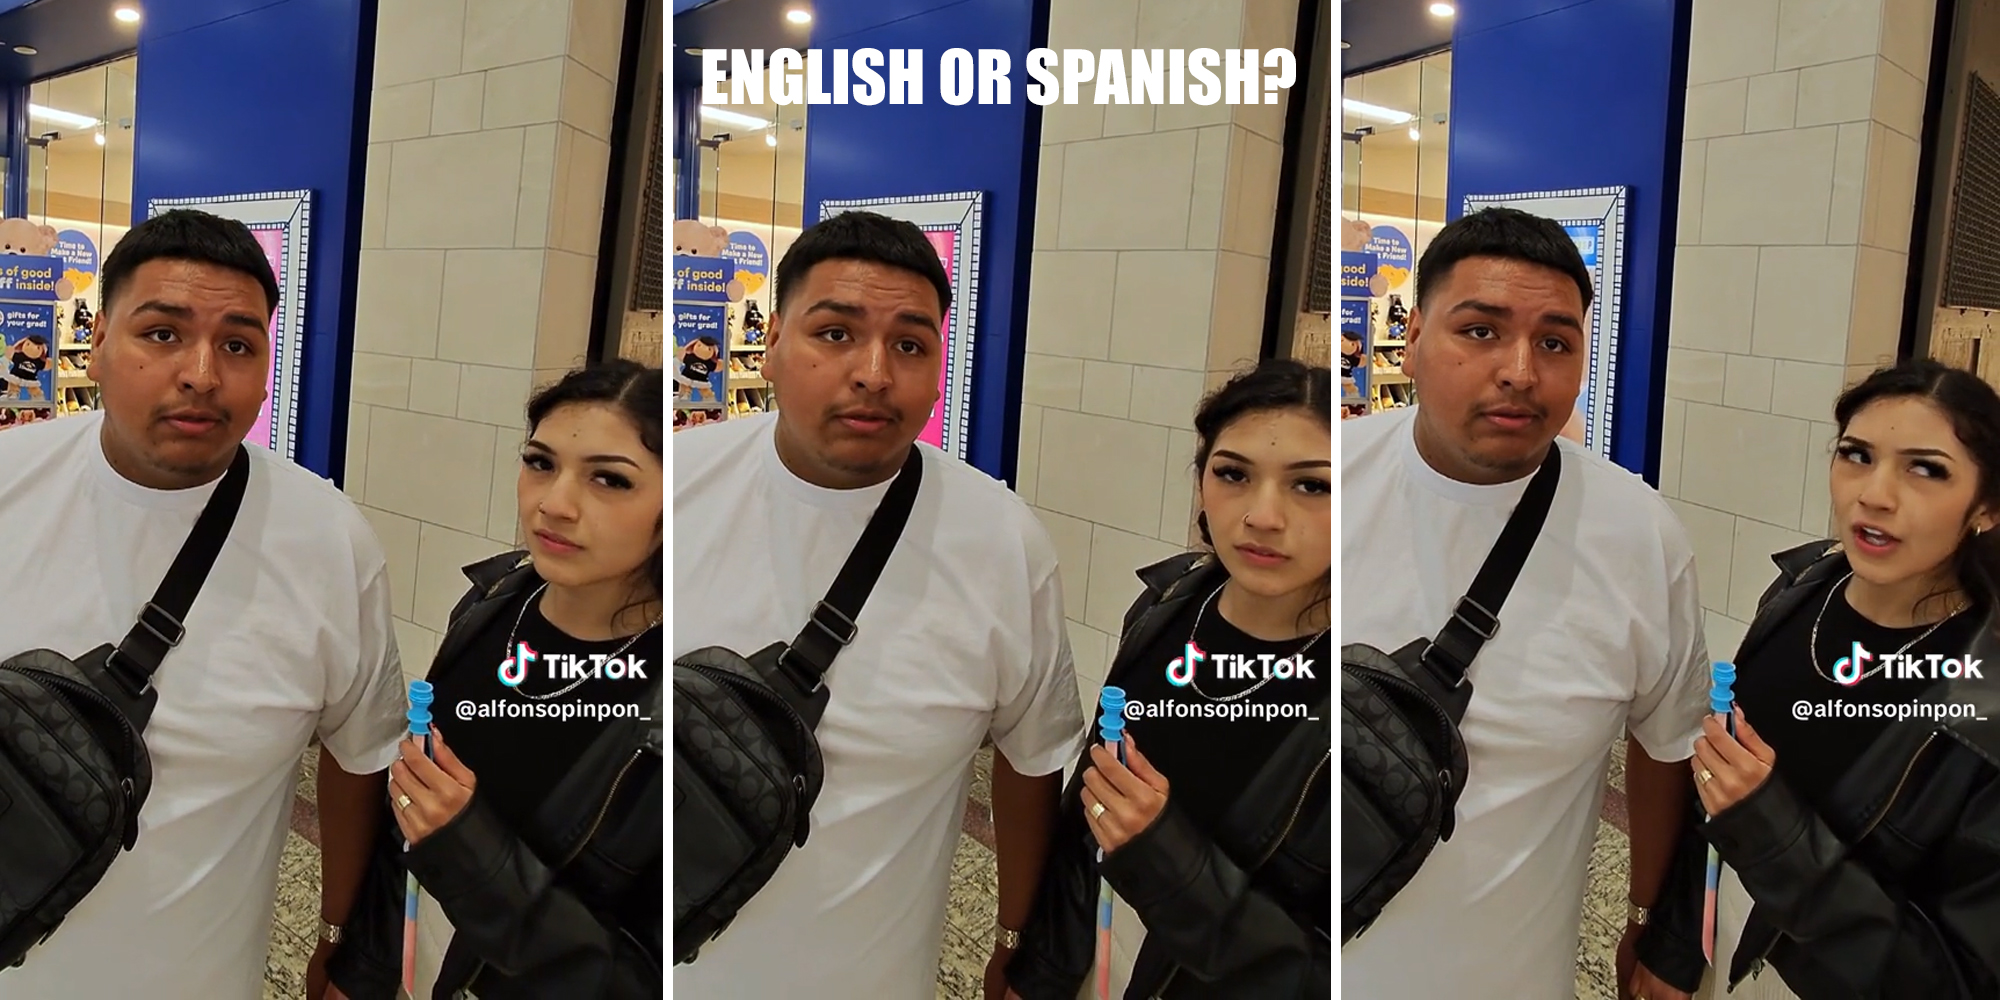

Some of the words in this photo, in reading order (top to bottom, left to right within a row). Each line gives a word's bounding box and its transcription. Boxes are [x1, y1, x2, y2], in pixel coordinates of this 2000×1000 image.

[59, 241, 76, 250] Time
[77, 242, 85, 250] to
[1373, 237, 1390, 245] Time
[1392, 238, 1399, 246] to
[730, 242, 747, 250] Time
[748, 243, 756, 251] to
[1365, 243, 1384, 251] Make
[50, 248, 70, 256] Make
[722, 249, 741, 257] Make
[748, 251, 763, 259] New
[6, 266, 19, 277] of
[21, 267, 52, 280] good
[677, 267, 690, 278] of
[692, 269, 723, 281] good
[16, 278, 54, 291] inside!
[687, 280, 726, 292] inside!
[7, 312, 26, 320] gifts
[1341, 308, 1354, 316] for
[678, 313, 697, 321] gifts
[699, 313, 711, 321] for
[7, 320, 24, 328] your
[26, 320, 47, 328] grad!
[678, 321, 696, 329] your
[697, 321, 718, 330] grad!
